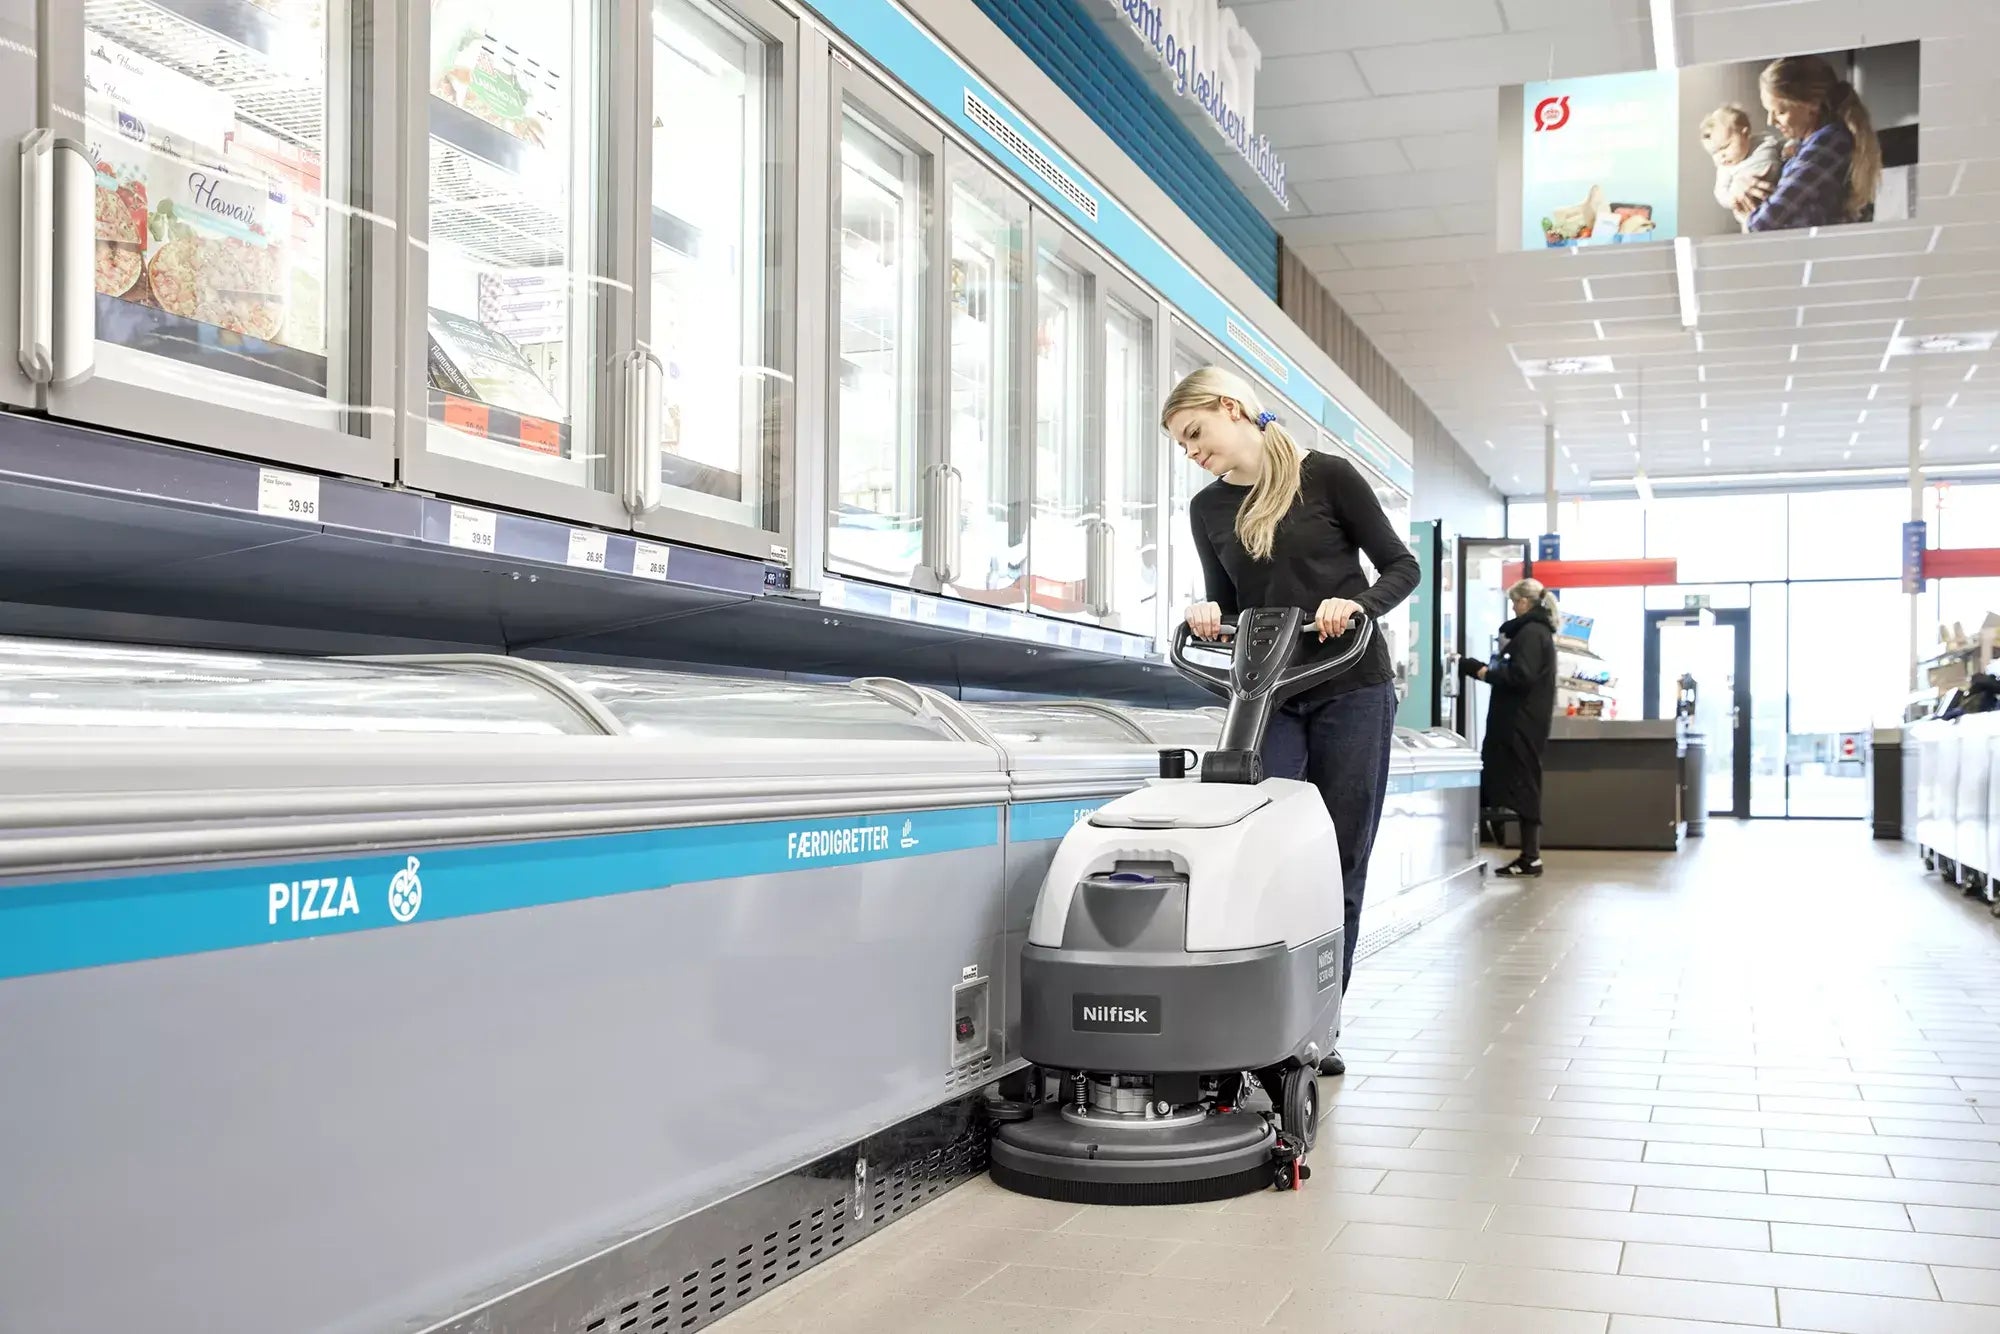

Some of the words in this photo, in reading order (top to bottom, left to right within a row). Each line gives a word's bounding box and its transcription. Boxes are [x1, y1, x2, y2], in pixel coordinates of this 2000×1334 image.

[1123, 0, 1163, 52] emt
[1166, 34, 1187, 94] og
[1191, 45, 1248, 154] lækkert
[189, 172, 255, 225] Hawaii
[431, 344, 471, 395] Flammekueche
[288, 499, 315, 514] 39.95
[471, 532, 492, 546] 39.95
[586, 551, 603, 563] 26.95
[650, 562, 666, 574] 26.95
[788, 825, 889, 860] FÆRDIGRETTER
[268, 876, 360, 925] PIZZA
[1083, 1006, 1148, 1023] Nilfisk
